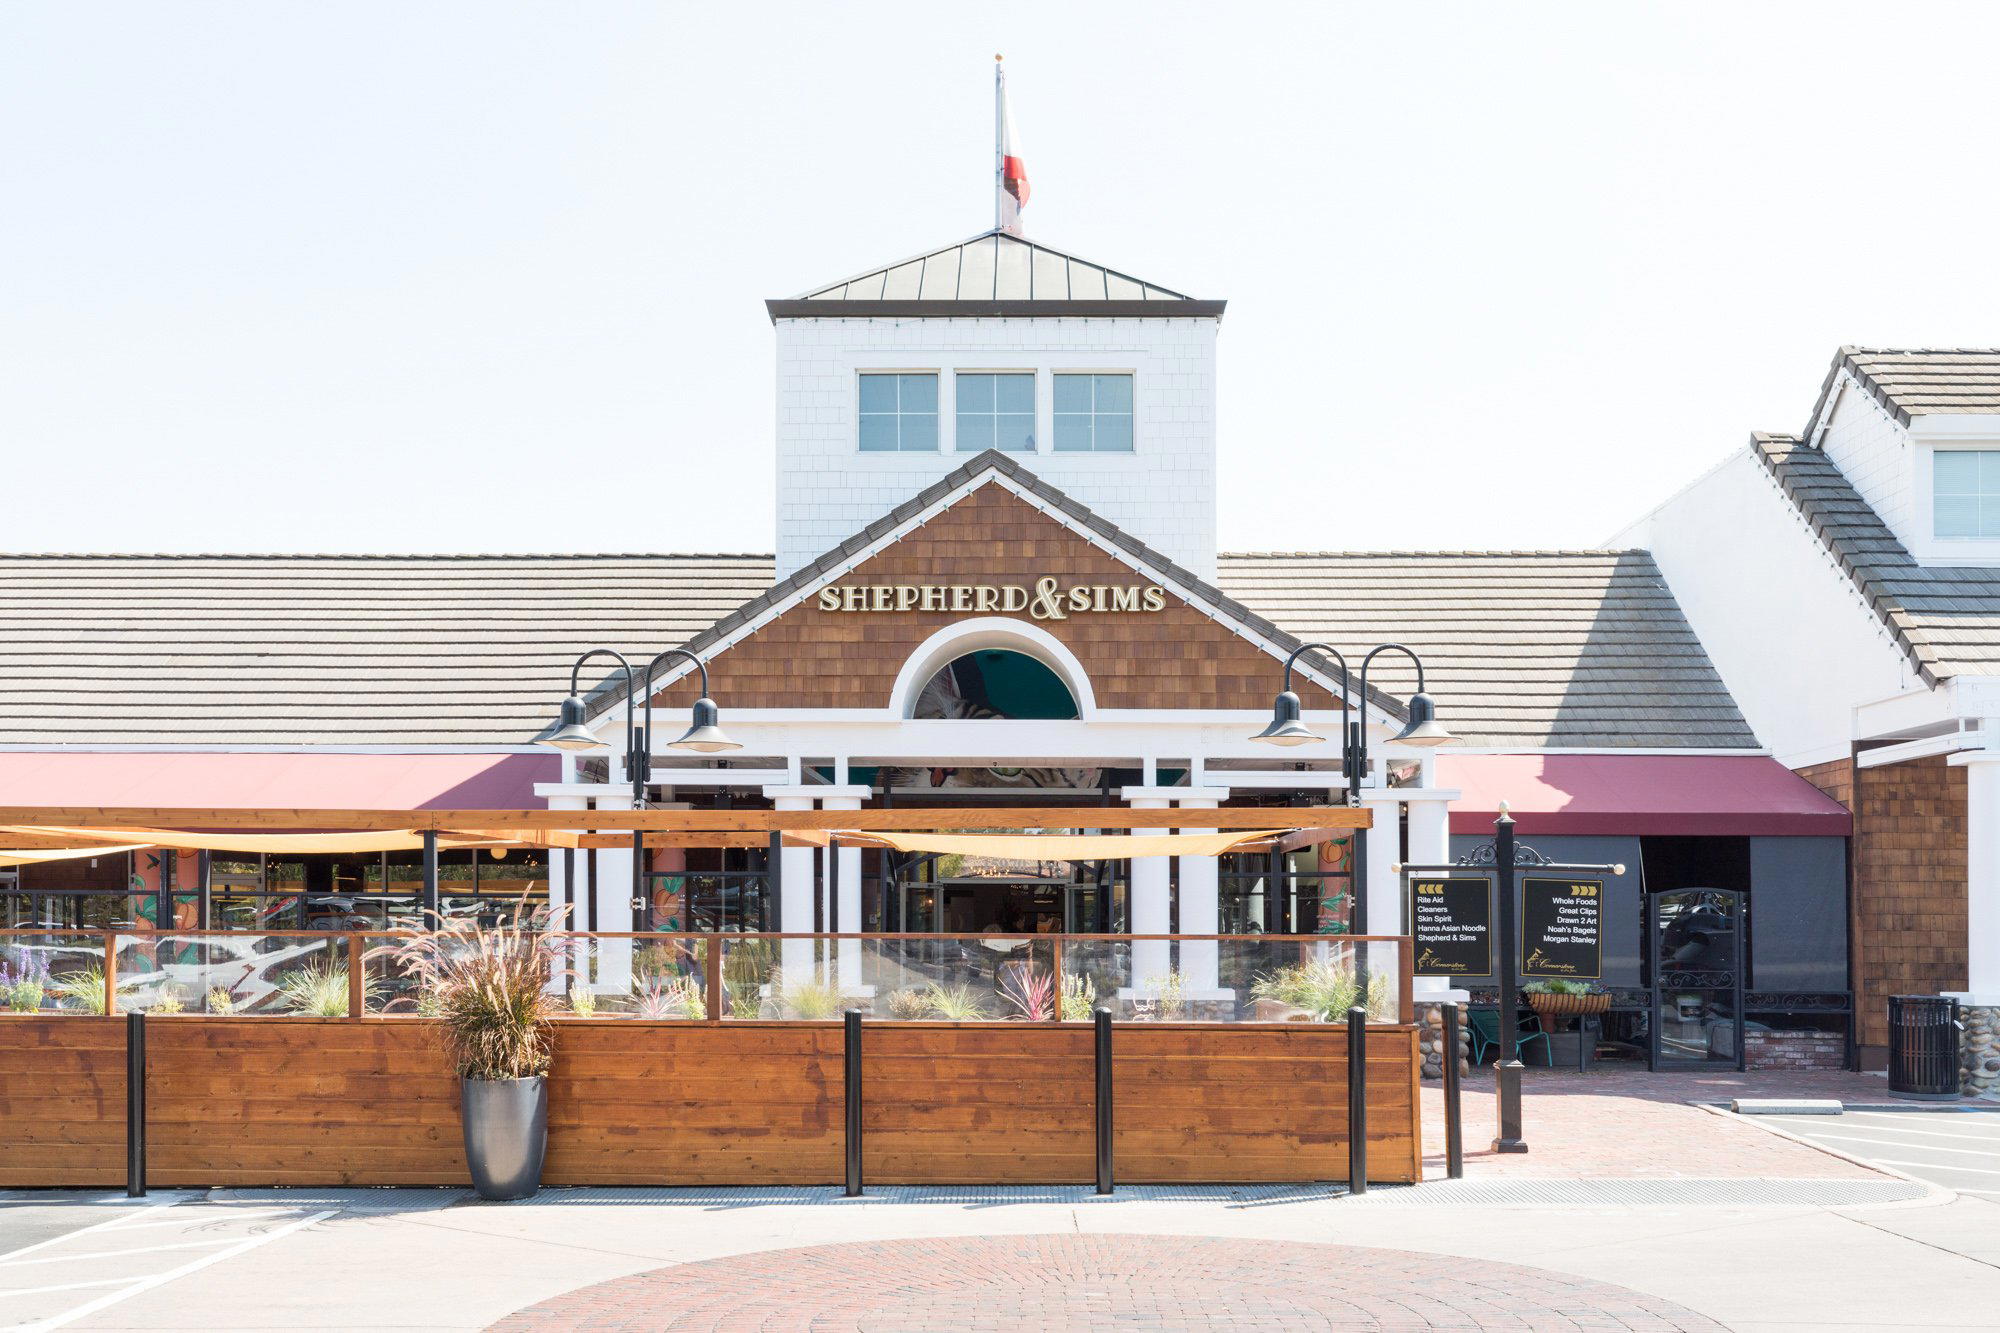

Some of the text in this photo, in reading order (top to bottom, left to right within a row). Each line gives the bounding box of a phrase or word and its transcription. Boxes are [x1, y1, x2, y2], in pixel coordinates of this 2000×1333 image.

[1552, 897, 1574, 905] Whole
[1579, 908, 1597, 916] Clips
[1434, 915, 1452, 923] Spirit
[1556, 916, 1579, 924] Drawn
[1547, 925, 1597, 935] Noah's Bagels
[1418, 934, 1451, 942] Shepherd
[1543, 935, 1597, 945] Morgan Stanley
